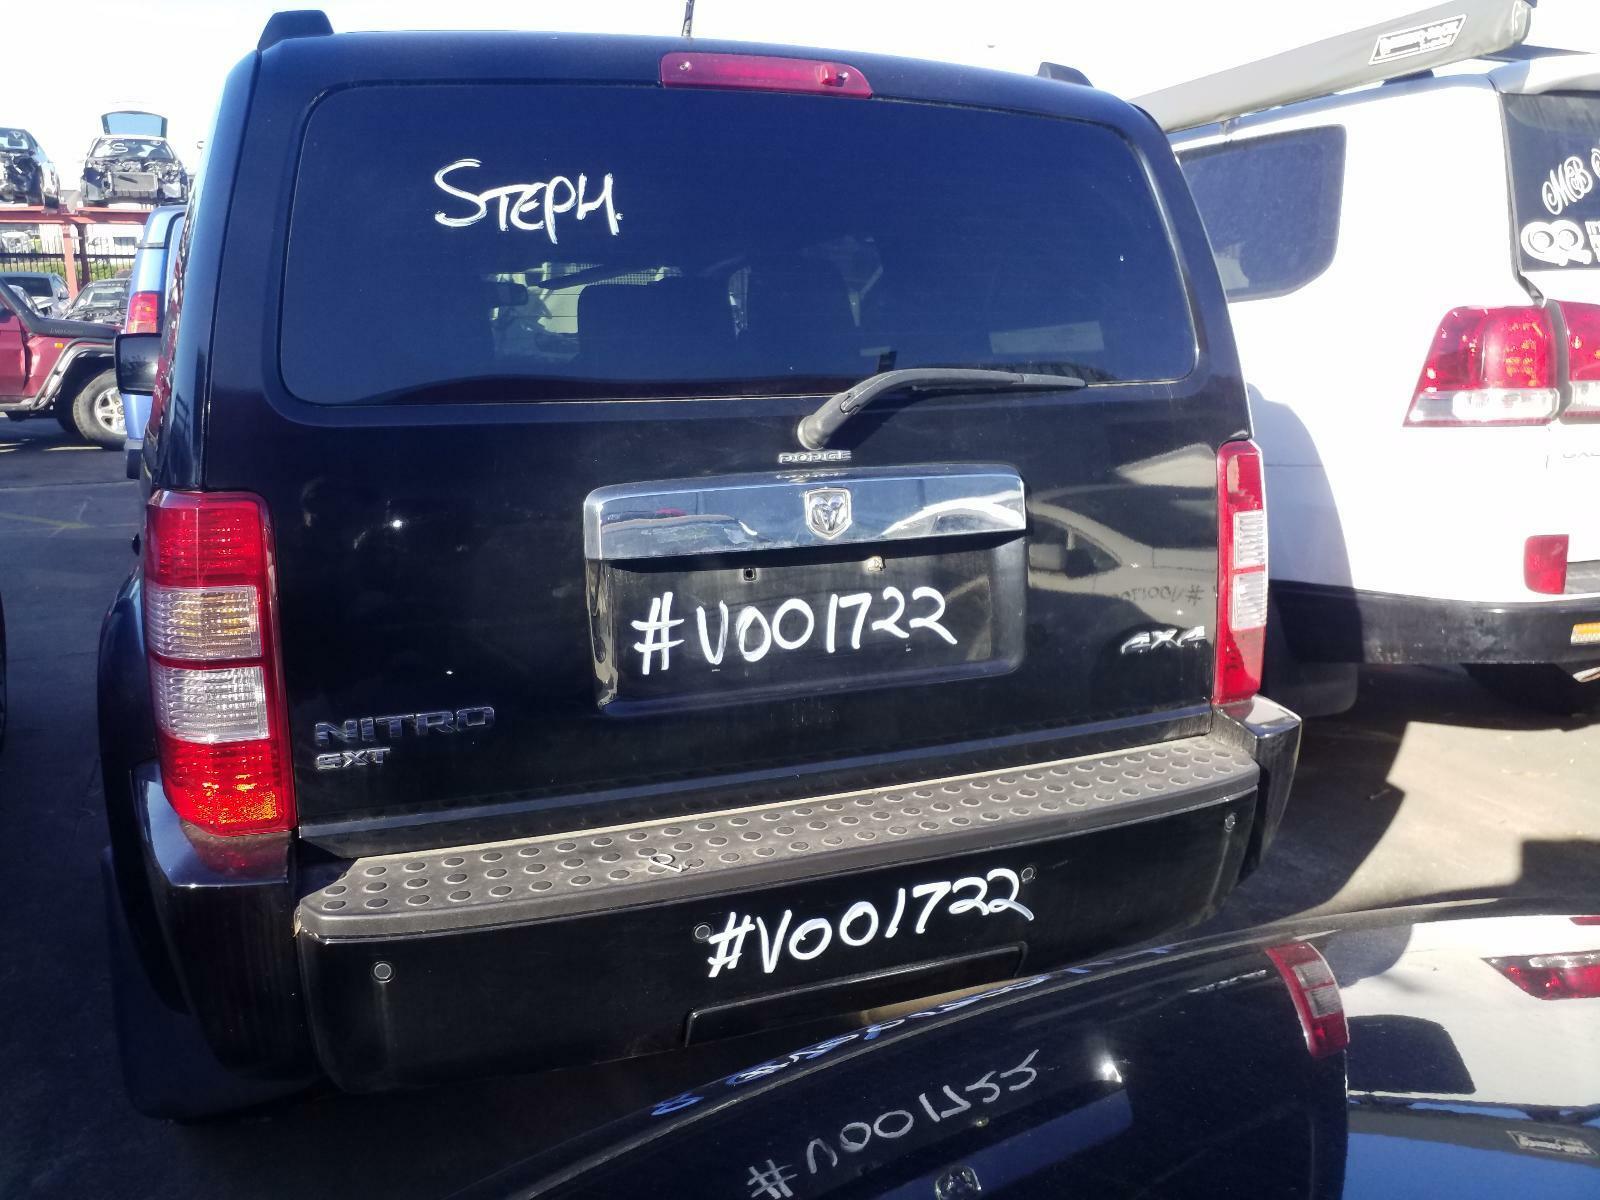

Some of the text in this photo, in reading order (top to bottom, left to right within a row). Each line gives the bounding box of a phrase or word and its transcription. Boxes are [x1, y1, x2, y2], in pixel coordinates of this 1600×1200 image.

[778, 450, 852, 464] DODGE
[315, 706, 495, 746] NITRO
[316, 747, 390, 770] EXT
[708, 868, 1034, 978] #V001722
